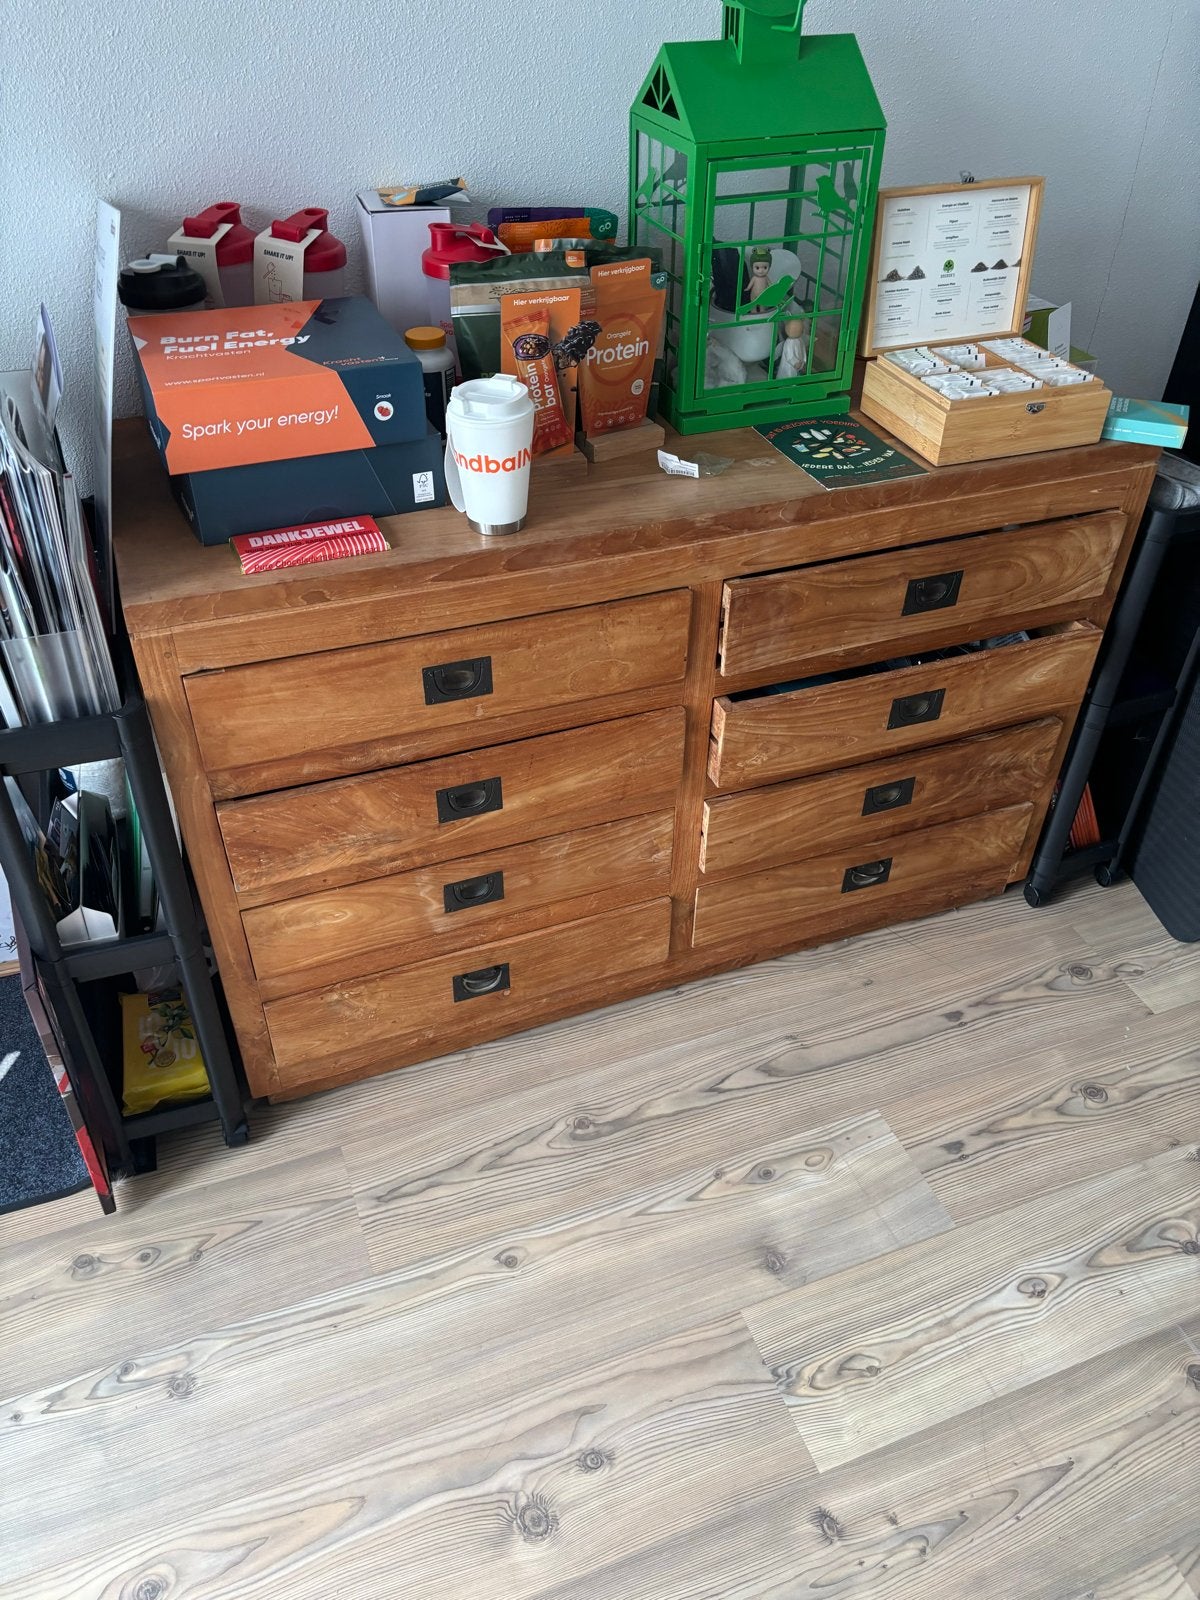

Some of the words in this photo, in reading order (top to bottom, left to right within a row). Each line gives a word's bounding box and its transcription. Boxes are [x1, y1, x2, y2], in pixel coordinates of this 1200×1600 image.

[598, 221, 612, 233] GO
[176, 249, 192, 258] SHAKE
[263, 249, 279, 258] SHAKE
[610, 264, 646, 276] verkrijgbaar
[656, 276, 665, 284] GO
[529, 295, 570, 305] verkrijgbaar
[160, 333, 219, 345] Burn
[226, 329, 274, 340] Fat,
[163, 341, 218, 354] Fuel
[223, 334, 311, 350] Energy
[165, 349, 251, 361] Krachtvasten
[586, 337, 649, 366] Protein
[322, 356, 361, 367] Kracht
[340, 359, 379, 367] vasten
[164, 371, 265, 387] www.sportvasten.nl
[526, 362, 545, 412] Protein
[544, 384, 557, 408] bar
[182, 418, 232, 441] Spark
[236, 416, 274, 436] your
[277, 404, 340, 428] energy!
[248, 520, 365, 548] DANKJEWEL
